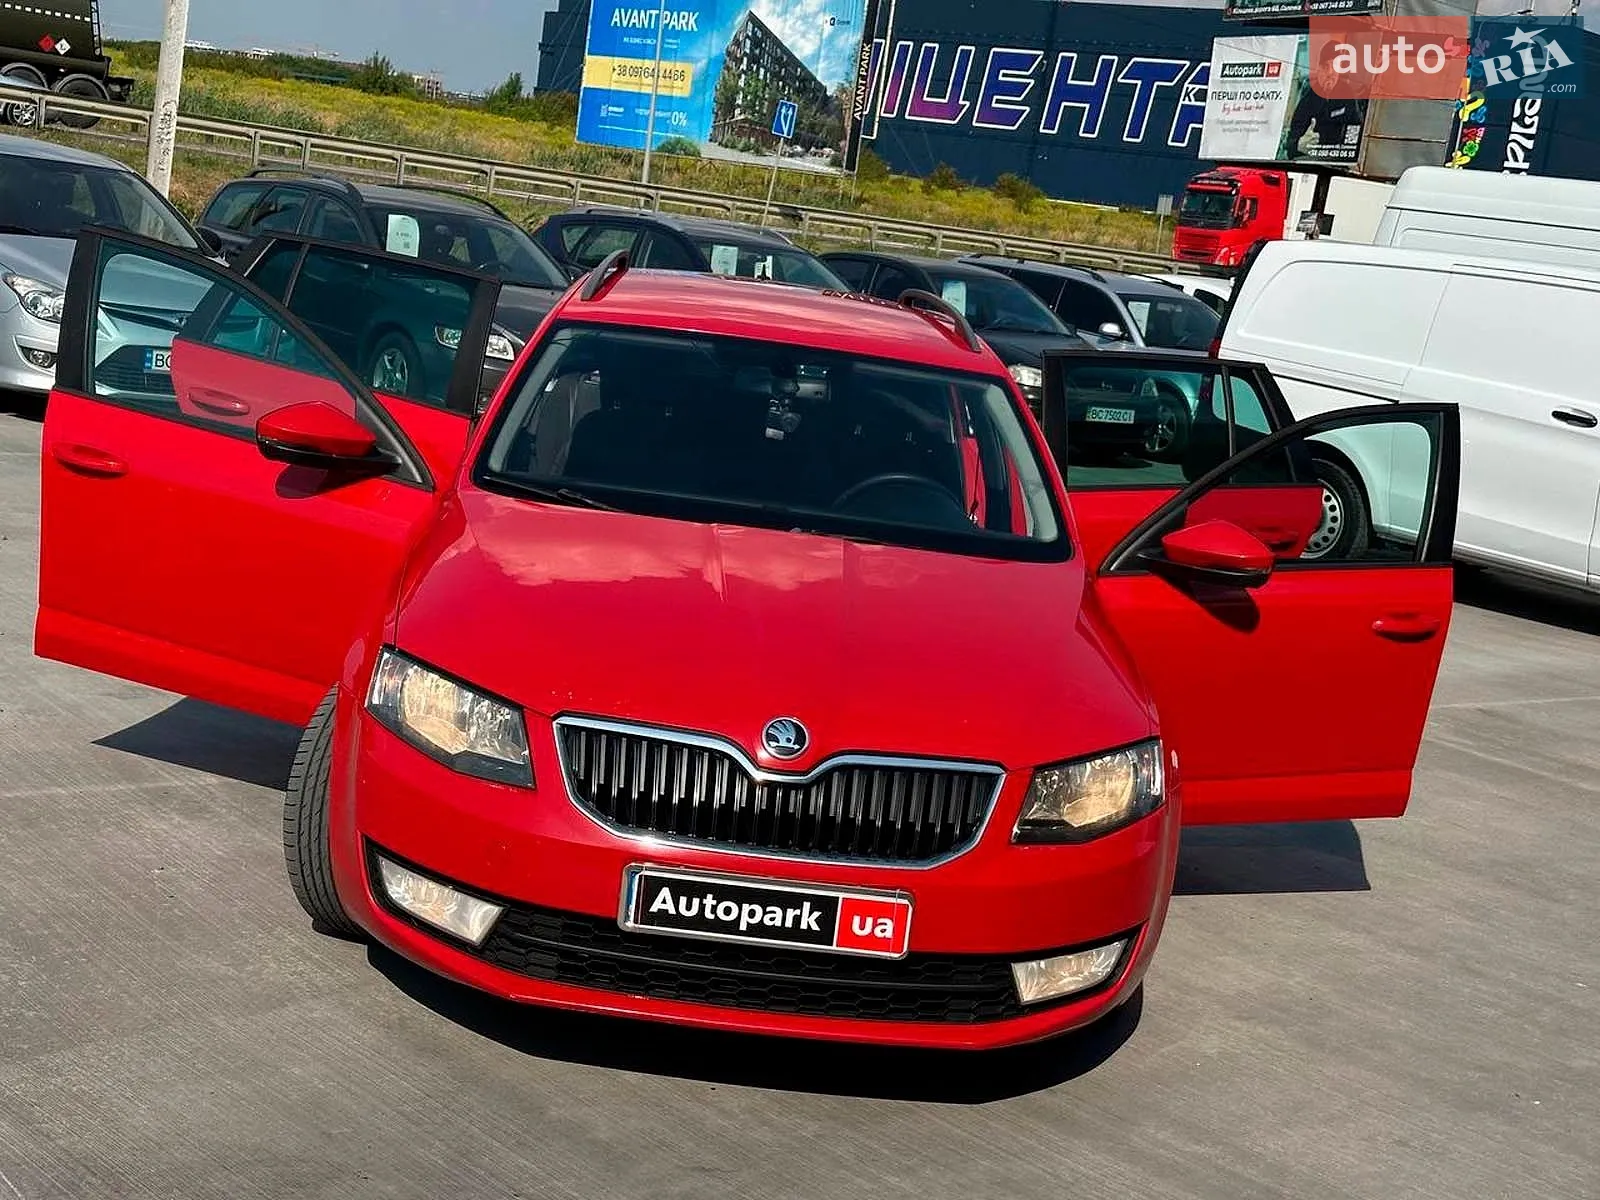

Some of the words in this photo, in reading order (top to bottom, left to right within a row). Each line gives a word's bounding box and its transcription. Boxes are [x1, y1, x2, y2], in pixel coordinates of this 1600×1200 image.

[611, 8, 659, 30] AVANT
[662, 11, 699, 32] PARK
[854, 79, 866, 120] AVANT
[860, 42, 871, 76] PARK
[1222, 64, 1263, 77] Autopark
[1211, 90, 1238, 101] ПЕРШІ
[1239, 91, 1252, 101] ПО
[649, 886, 822, 931] Autopark
[851, 914, 895, 939] ua
